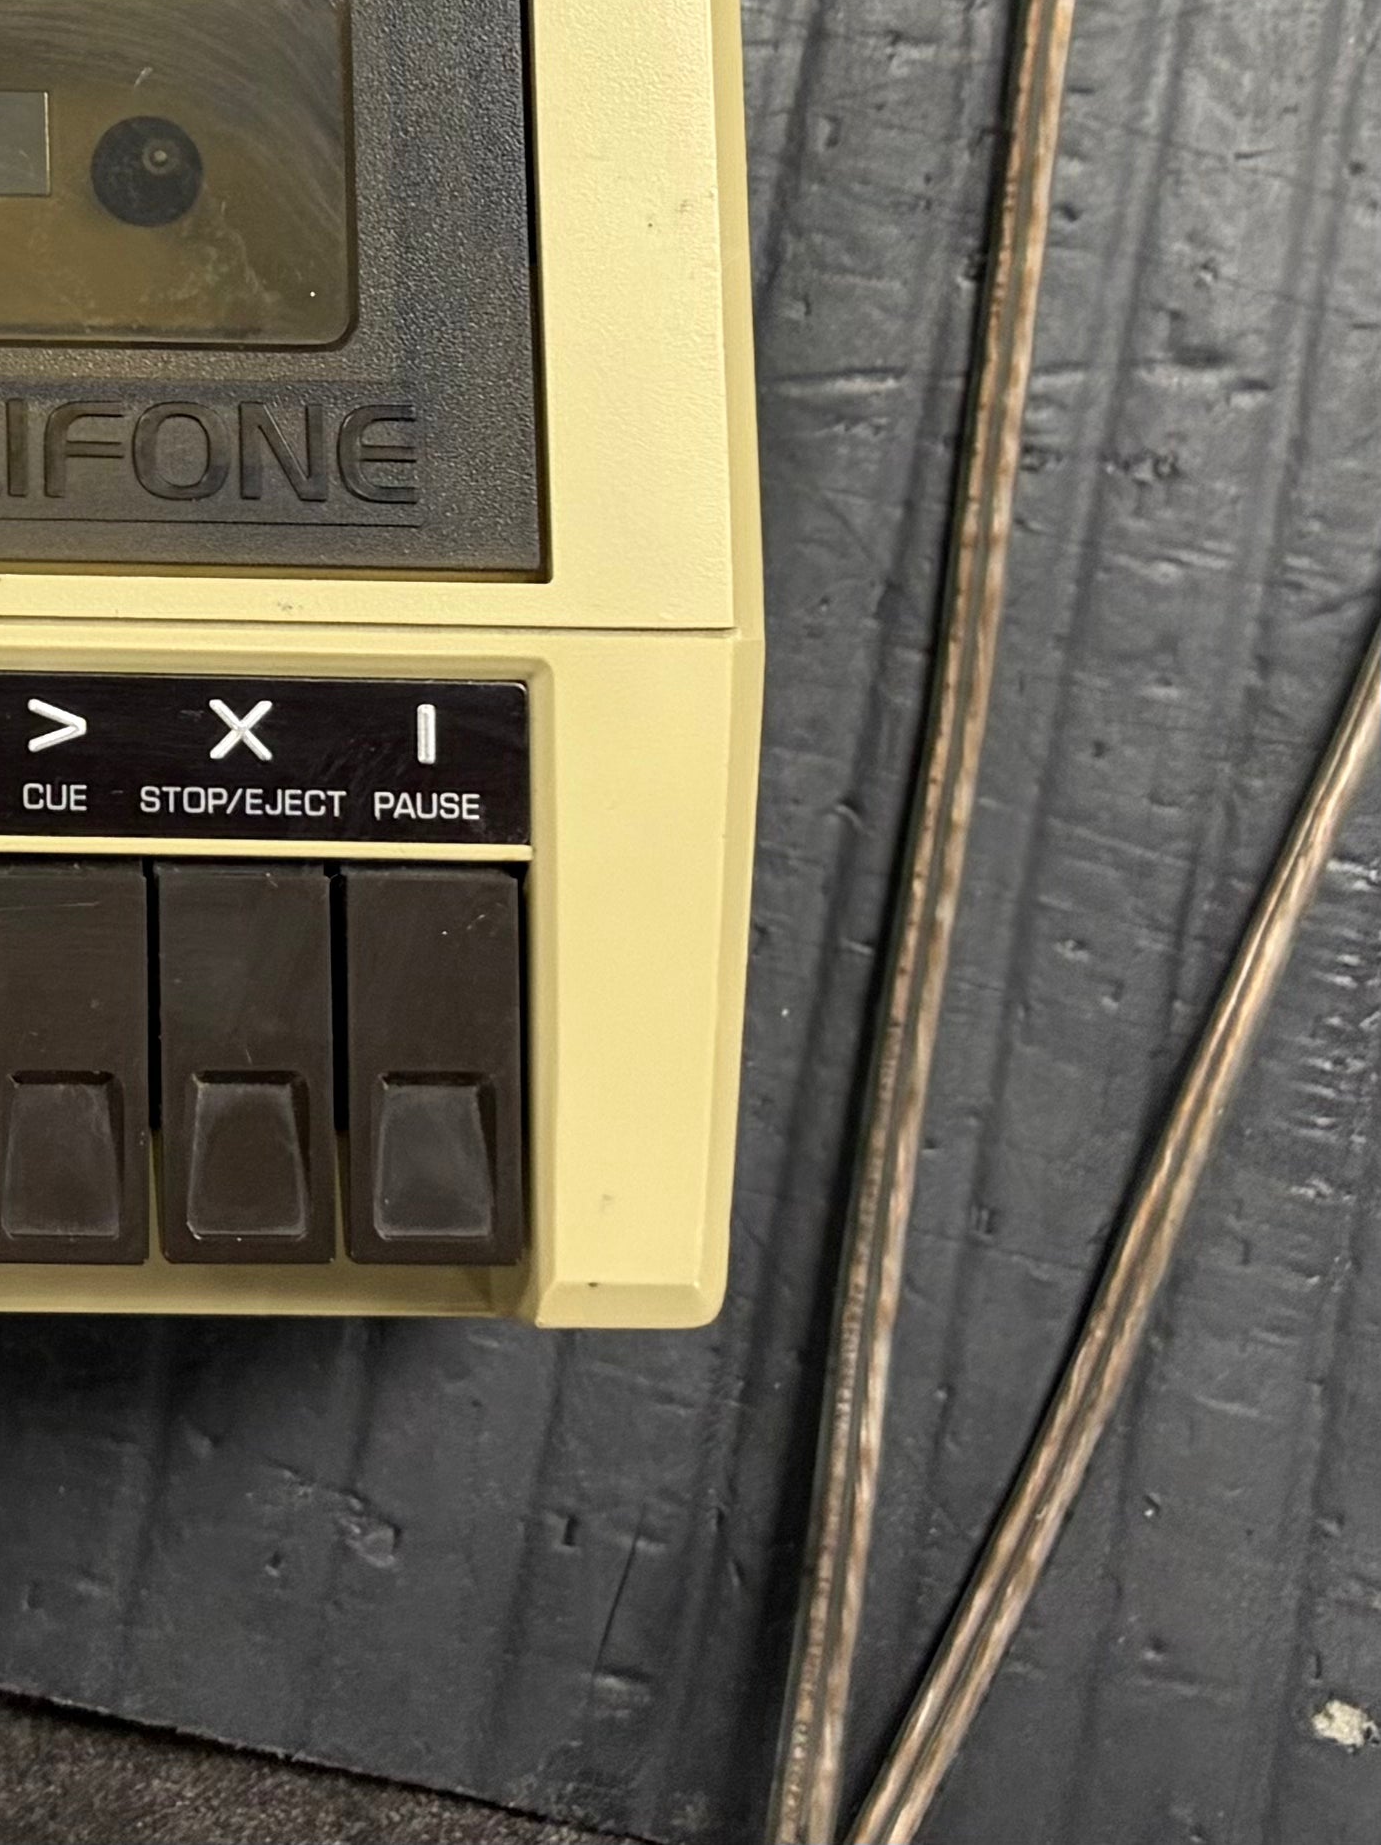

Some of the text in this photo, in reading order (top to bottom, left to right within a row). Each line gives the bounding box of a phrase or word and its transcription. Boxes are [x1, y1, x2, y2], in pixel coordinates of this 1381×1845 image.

[22, 782, 88, 811] CUE
[140, 786, 347, 817] STOP/EJECT
[373, 791, 480, 821] PAUSE
